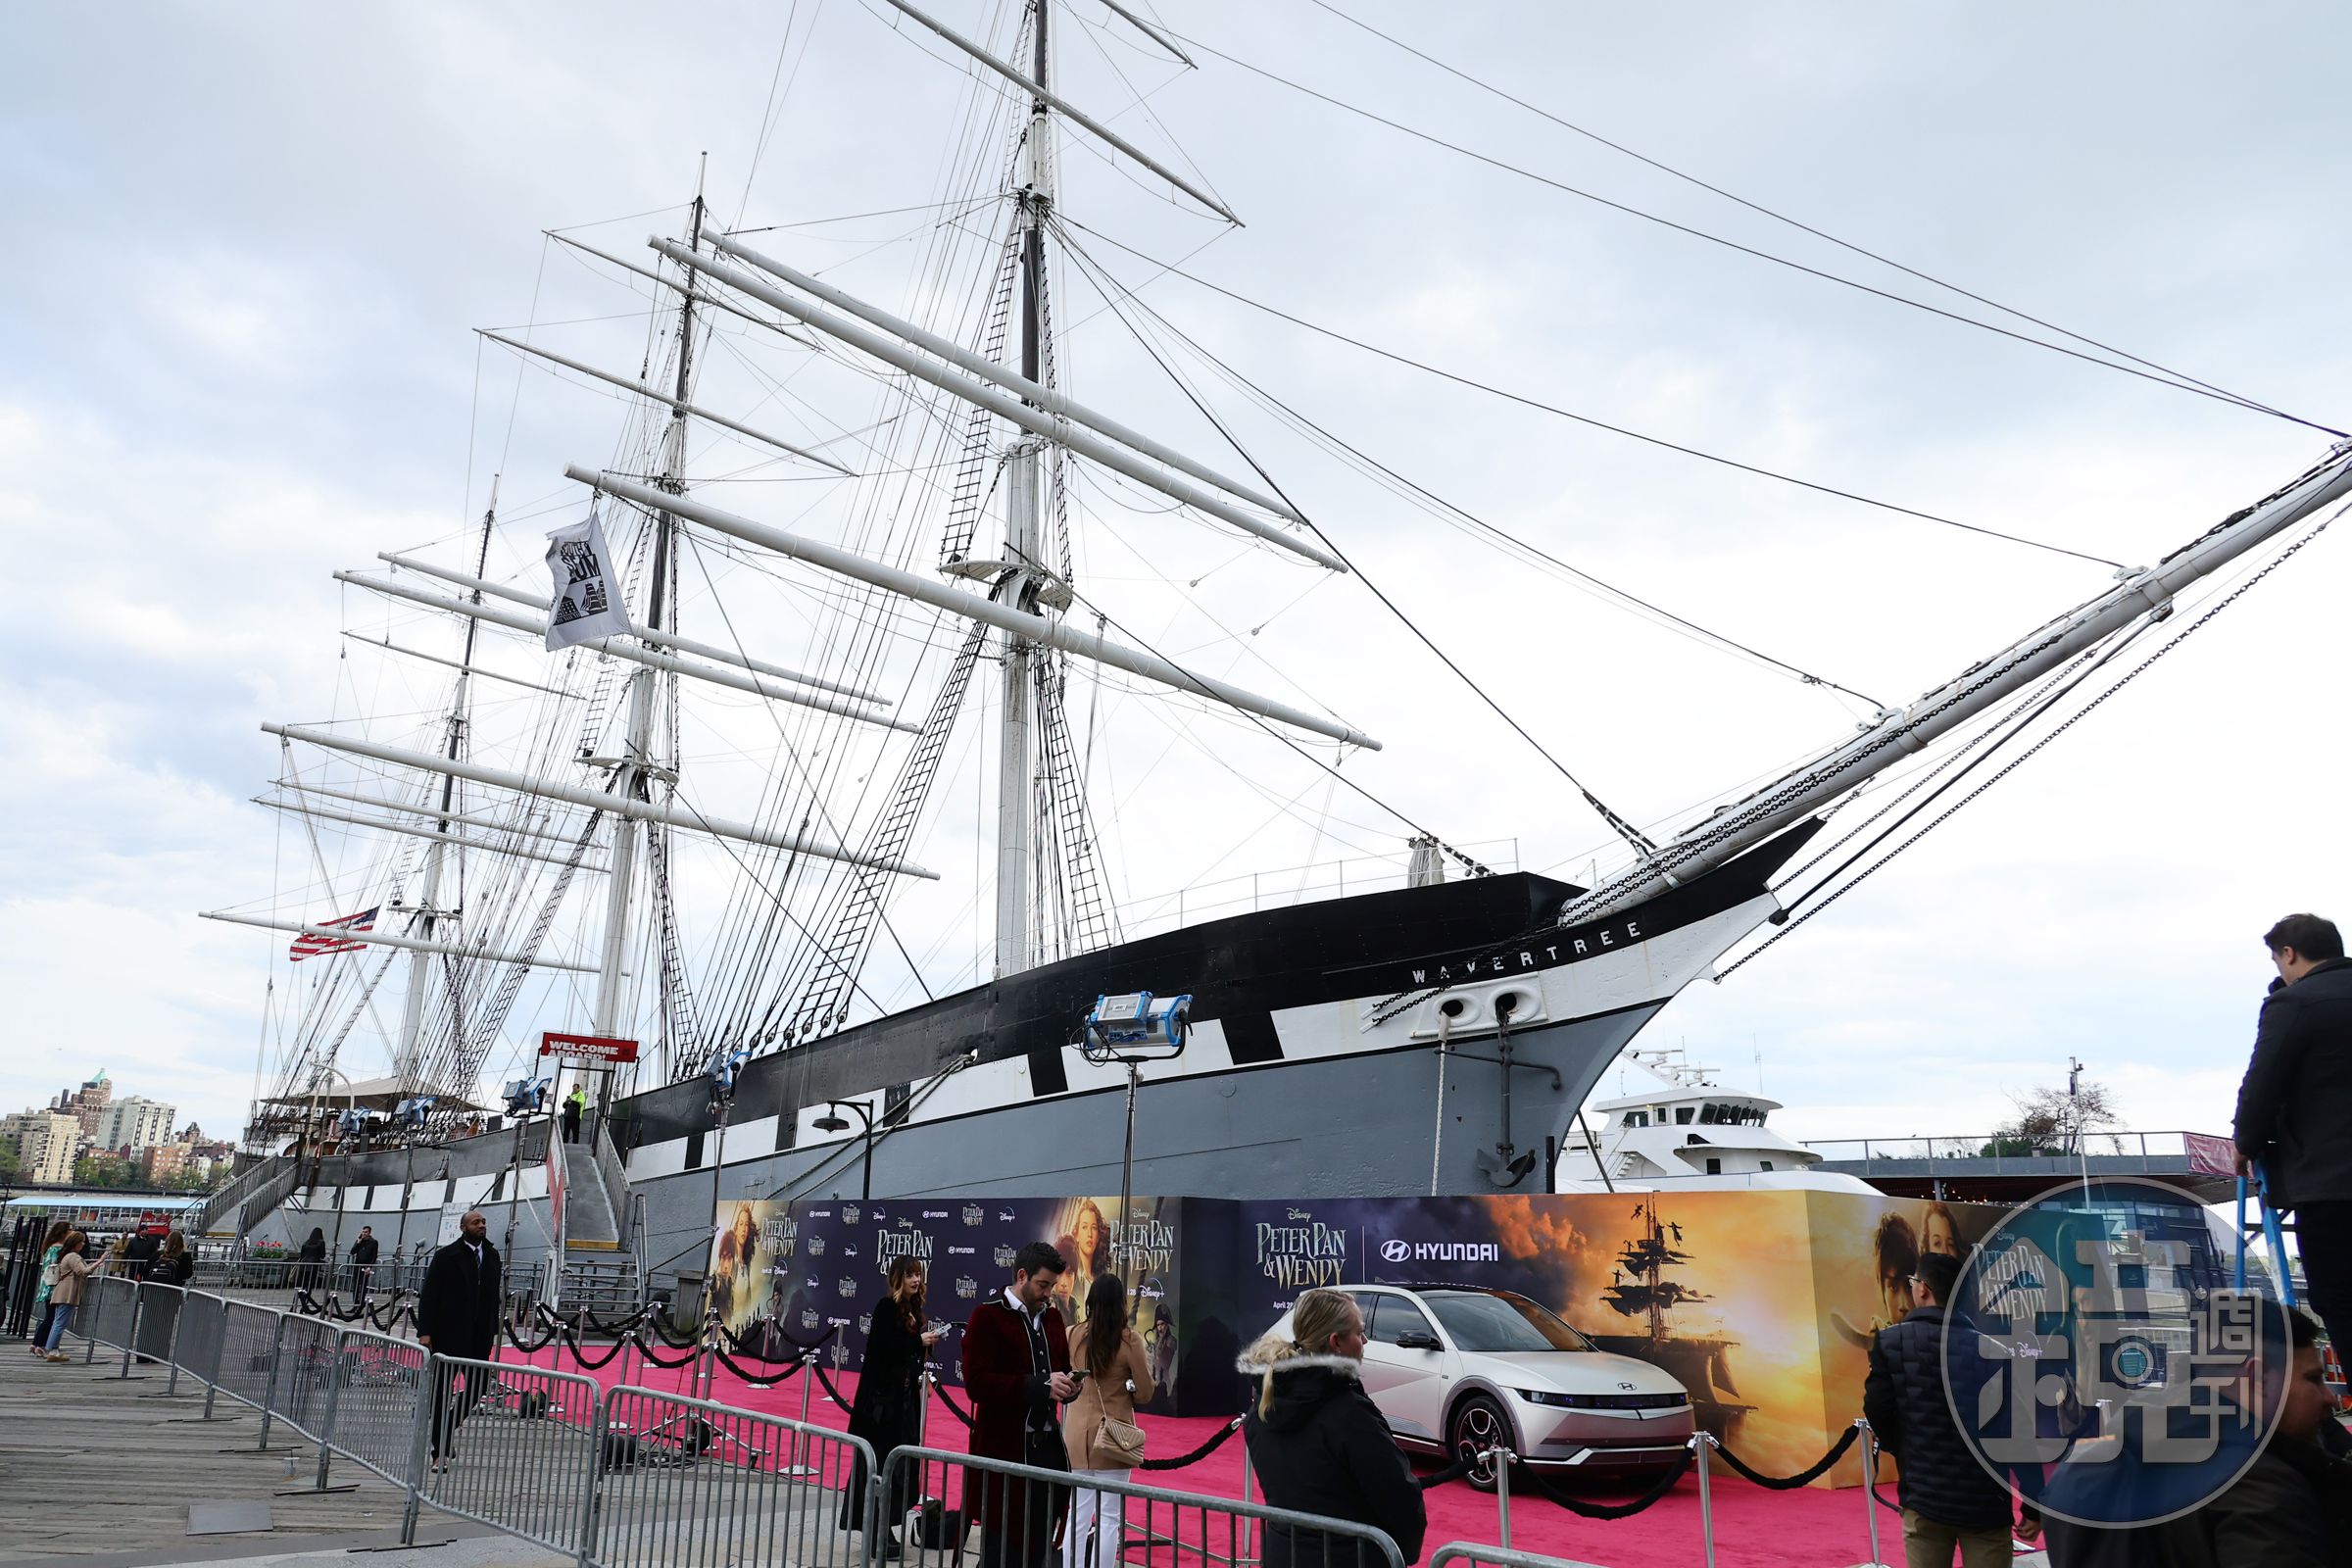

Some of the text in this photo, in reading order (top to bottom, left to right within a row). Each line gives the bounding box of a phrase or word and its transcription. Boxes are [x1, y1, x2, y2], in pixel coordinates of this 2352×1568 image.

[1412, 921, 1641, 984] WAVERTREE
[549, 1040, 619, 1055] WELCOME
[1286, 1207, 1311, 1223] Disney
[760, 1217, 799, 1243] PETER PAN
[1150, 1220, 1175, 1248] PAN
[1255, 1222, 1347, 1265] PETER PAN
[875, 1229, 934, 1264] PETER PAN
[1415, 1243, 1499, 1262] HYUNDAI
[1971, 1243, 2046, 1295] PETER PAN
[1273, 1300, 1286, 1309] April
